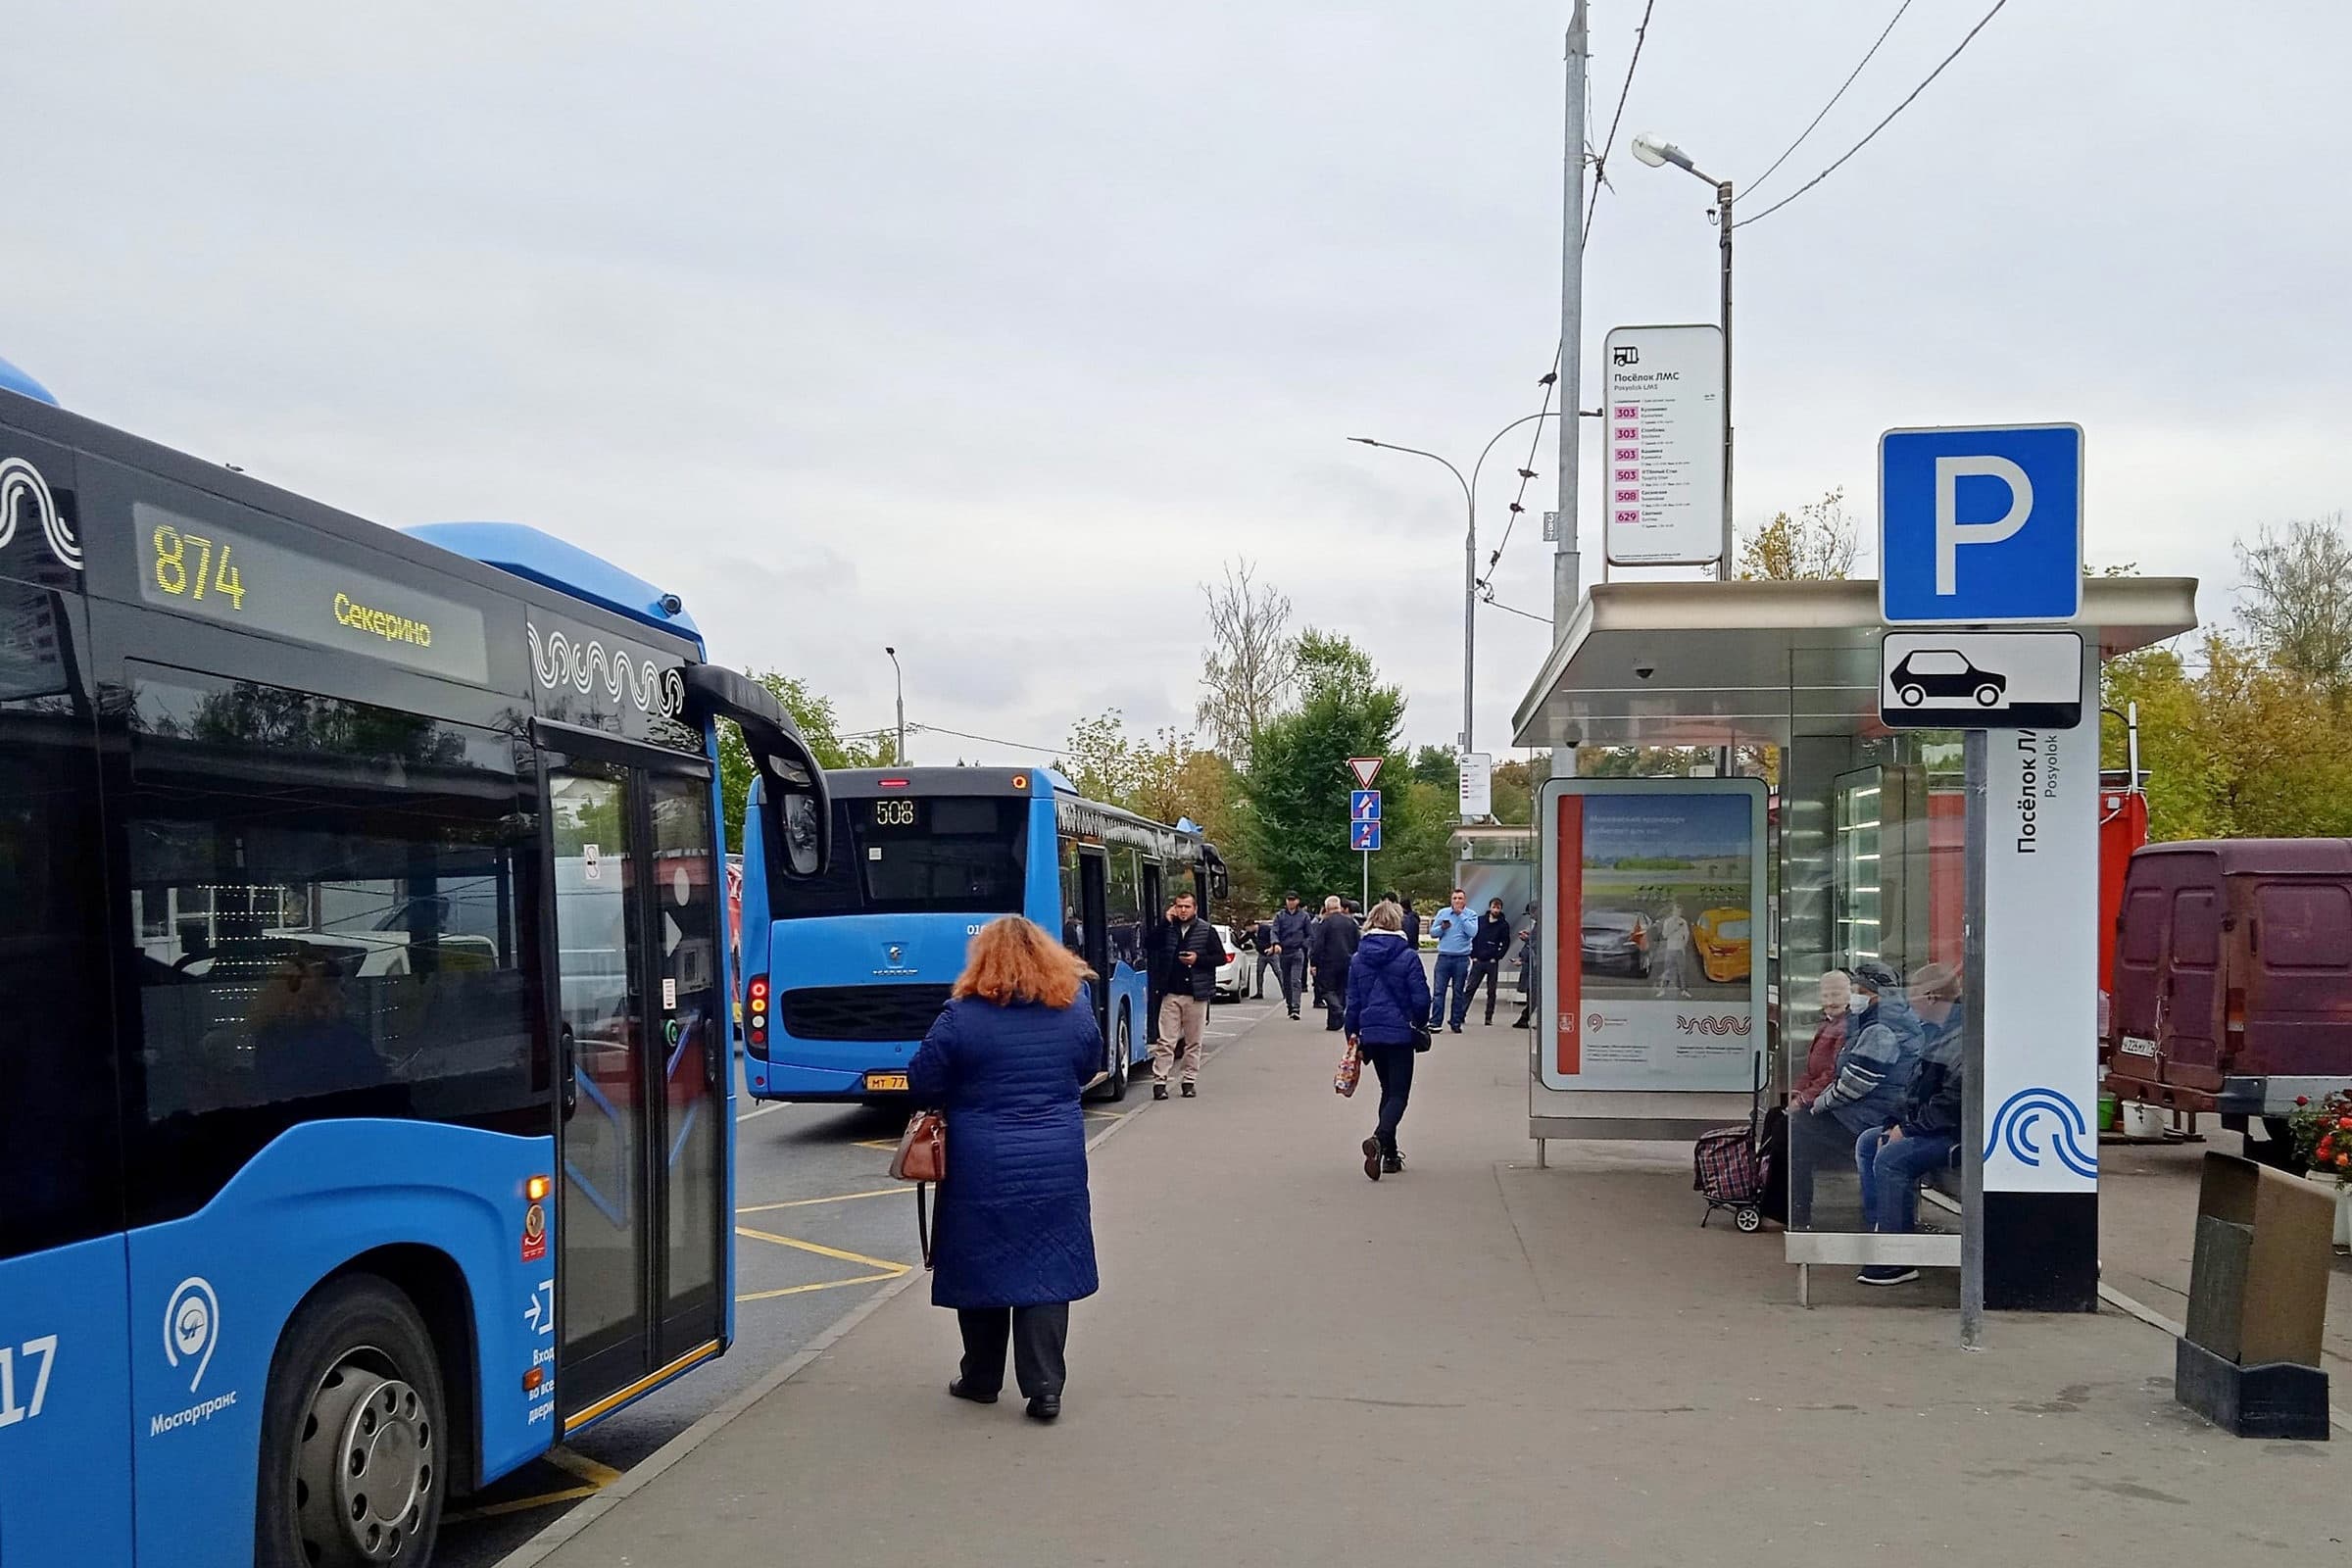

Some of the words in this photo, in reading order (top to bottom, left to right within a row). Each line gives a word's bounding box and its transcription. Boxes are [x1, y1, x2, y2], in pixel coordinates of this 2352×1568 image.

[1614, 372, 1654, 382] Посёлок
[1655, 371, 1680, 381] ЛМС
[1617, 409, 1636, 417] 303
[1617, 429, 1636, 438] 303
[1617, 450, 1636, 460] 503
[1618, 470, 1636, 480] 503
[1618, 491, 1637, 501] 508
[1617, 512, 1637, 521] 629
[1936, 455, 2034, 596] P
[153, 524, 246, 611] 874
[333, 592, 431, 648] Секерино
[2044, 734, 2060, 798] Posyolok
[876, 800, 913, 824] 508
[2017, 759, 2036, 854] Посёлок
[533, 1347, 555, 1366] Вход
[529, 1387, 540, 1401] во
[541, 1379, 555, 1396] все
[150, 1391, 237, 1438] Мосгортранс
